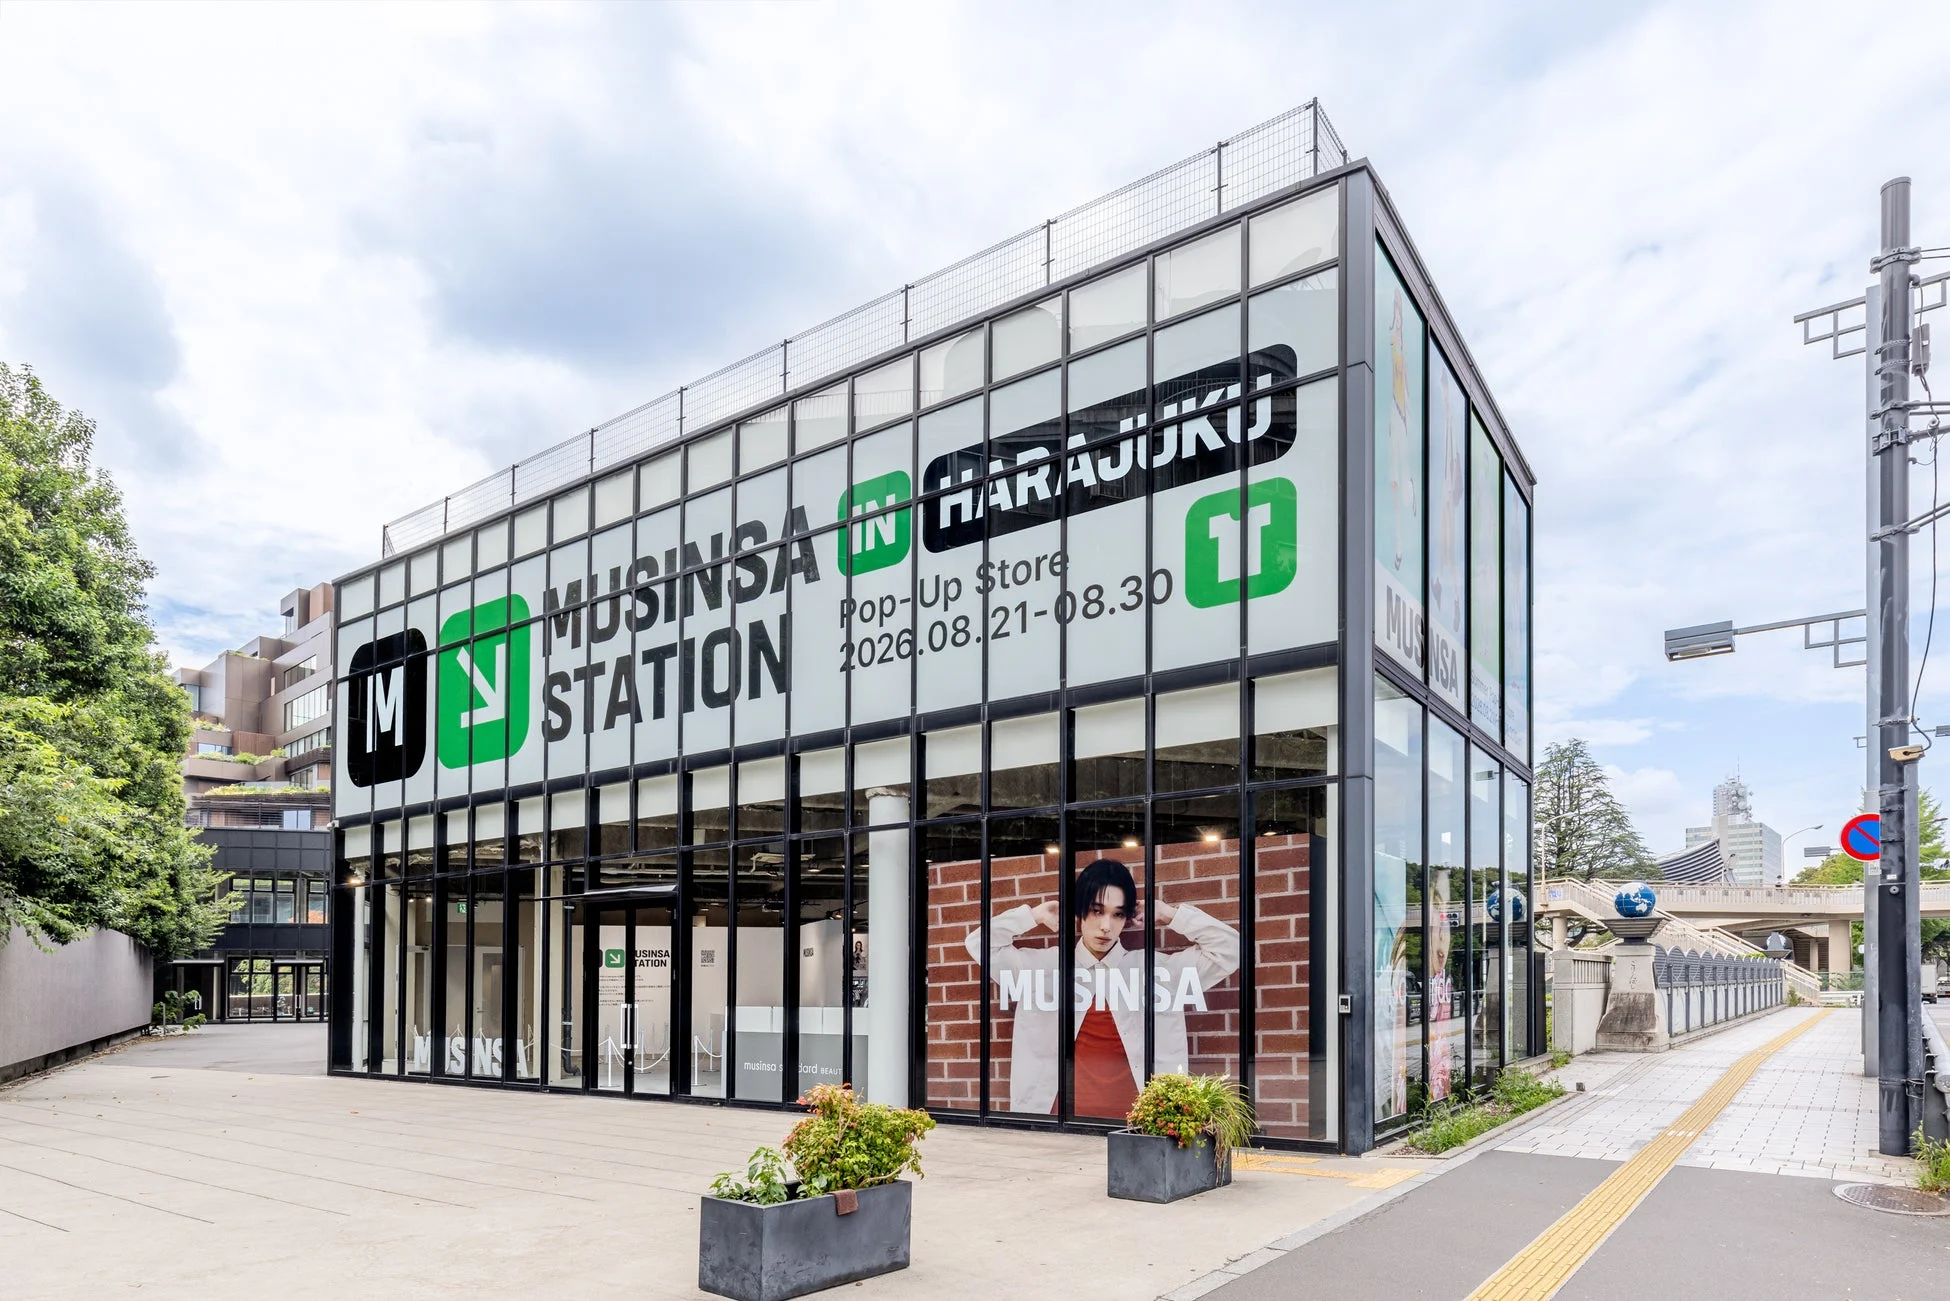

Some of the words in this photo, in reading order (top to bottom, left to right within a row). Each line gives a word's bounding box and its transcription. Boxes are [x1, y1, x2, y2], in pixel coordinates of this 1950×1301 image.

[853, 494, 896, 555] IN
[939, 373, 1271, 529] HARAJUKU
[542, 505, 820, 657] MUSINSA
[839, 573, 962, 629] Pop-Up
[975, 550, 1070, 595] Store
[839, 568, 1174, 672] 2026.08.21-08.30
[542, 611, 792, 743] STATION
[1386, 585, 1459, 699] MUSNSA
[366, 666, 403, 753] M
[635, 950, 670, 958] USINSA
[635, 959, 667, 968] TATION
[1000, 966, 1208, 1013] MUSINSA
[414, 1036, 528, 1078] MSNSA
[744, 1061, 776, 1072] musinsa
[779, 1063, 818, 1074] sdard
[821, 1067, 843, 1075] BEAUT
